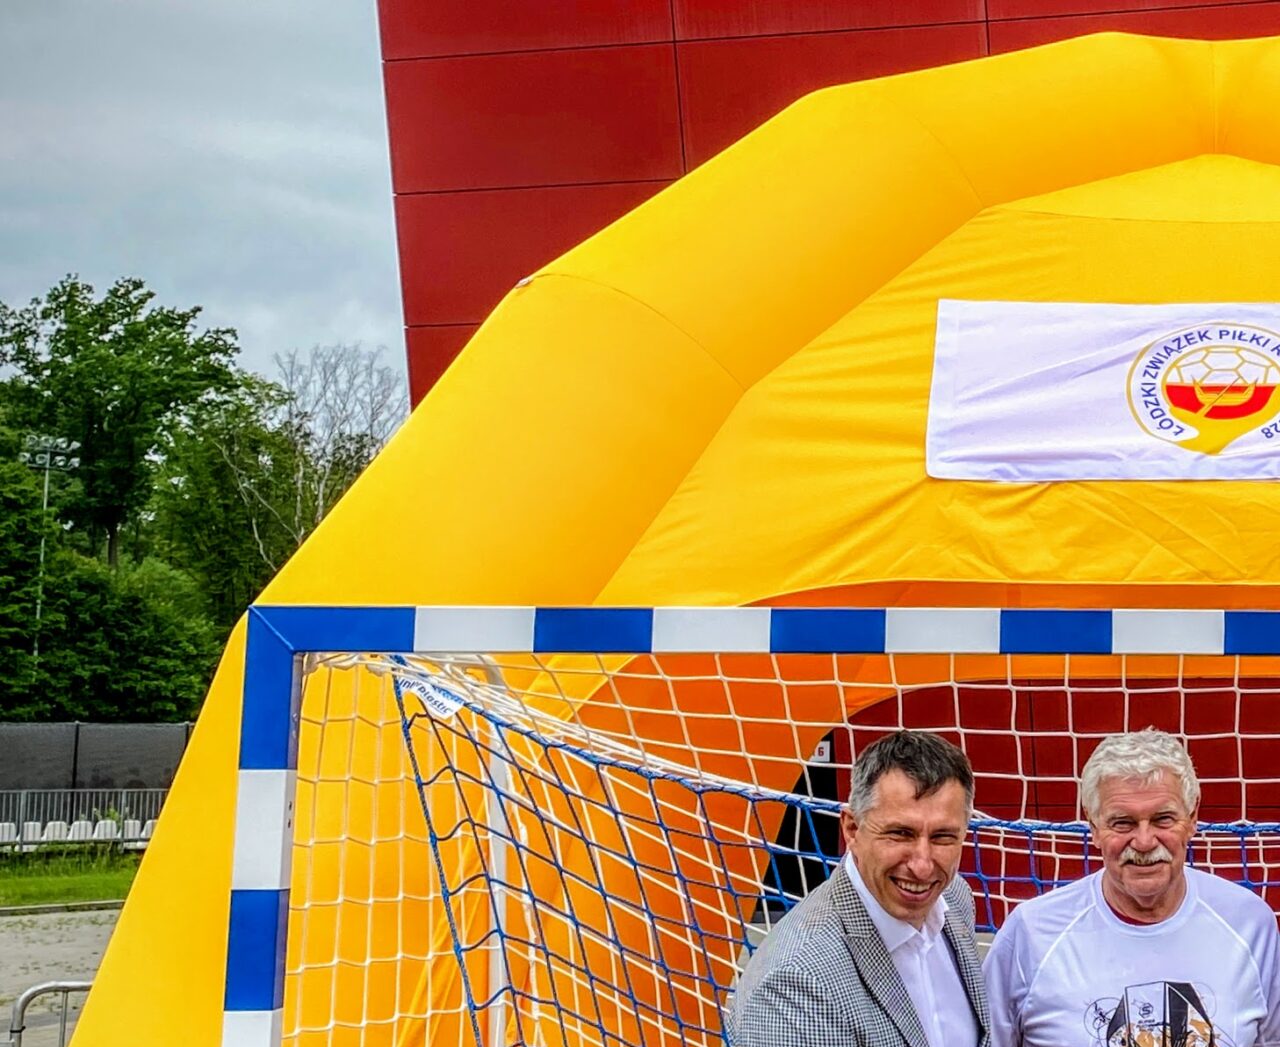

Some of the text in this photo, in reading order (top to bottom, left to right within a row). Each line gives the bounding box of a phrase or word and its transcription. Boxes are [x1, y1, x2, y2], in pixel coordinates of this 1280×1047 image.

[1142, 329, 1212, 380] ZWIĄZEK
[1218, 329, 1272, 348] PIŁKI
[1141, 381, 1185, 437] ŁÓDZKI
